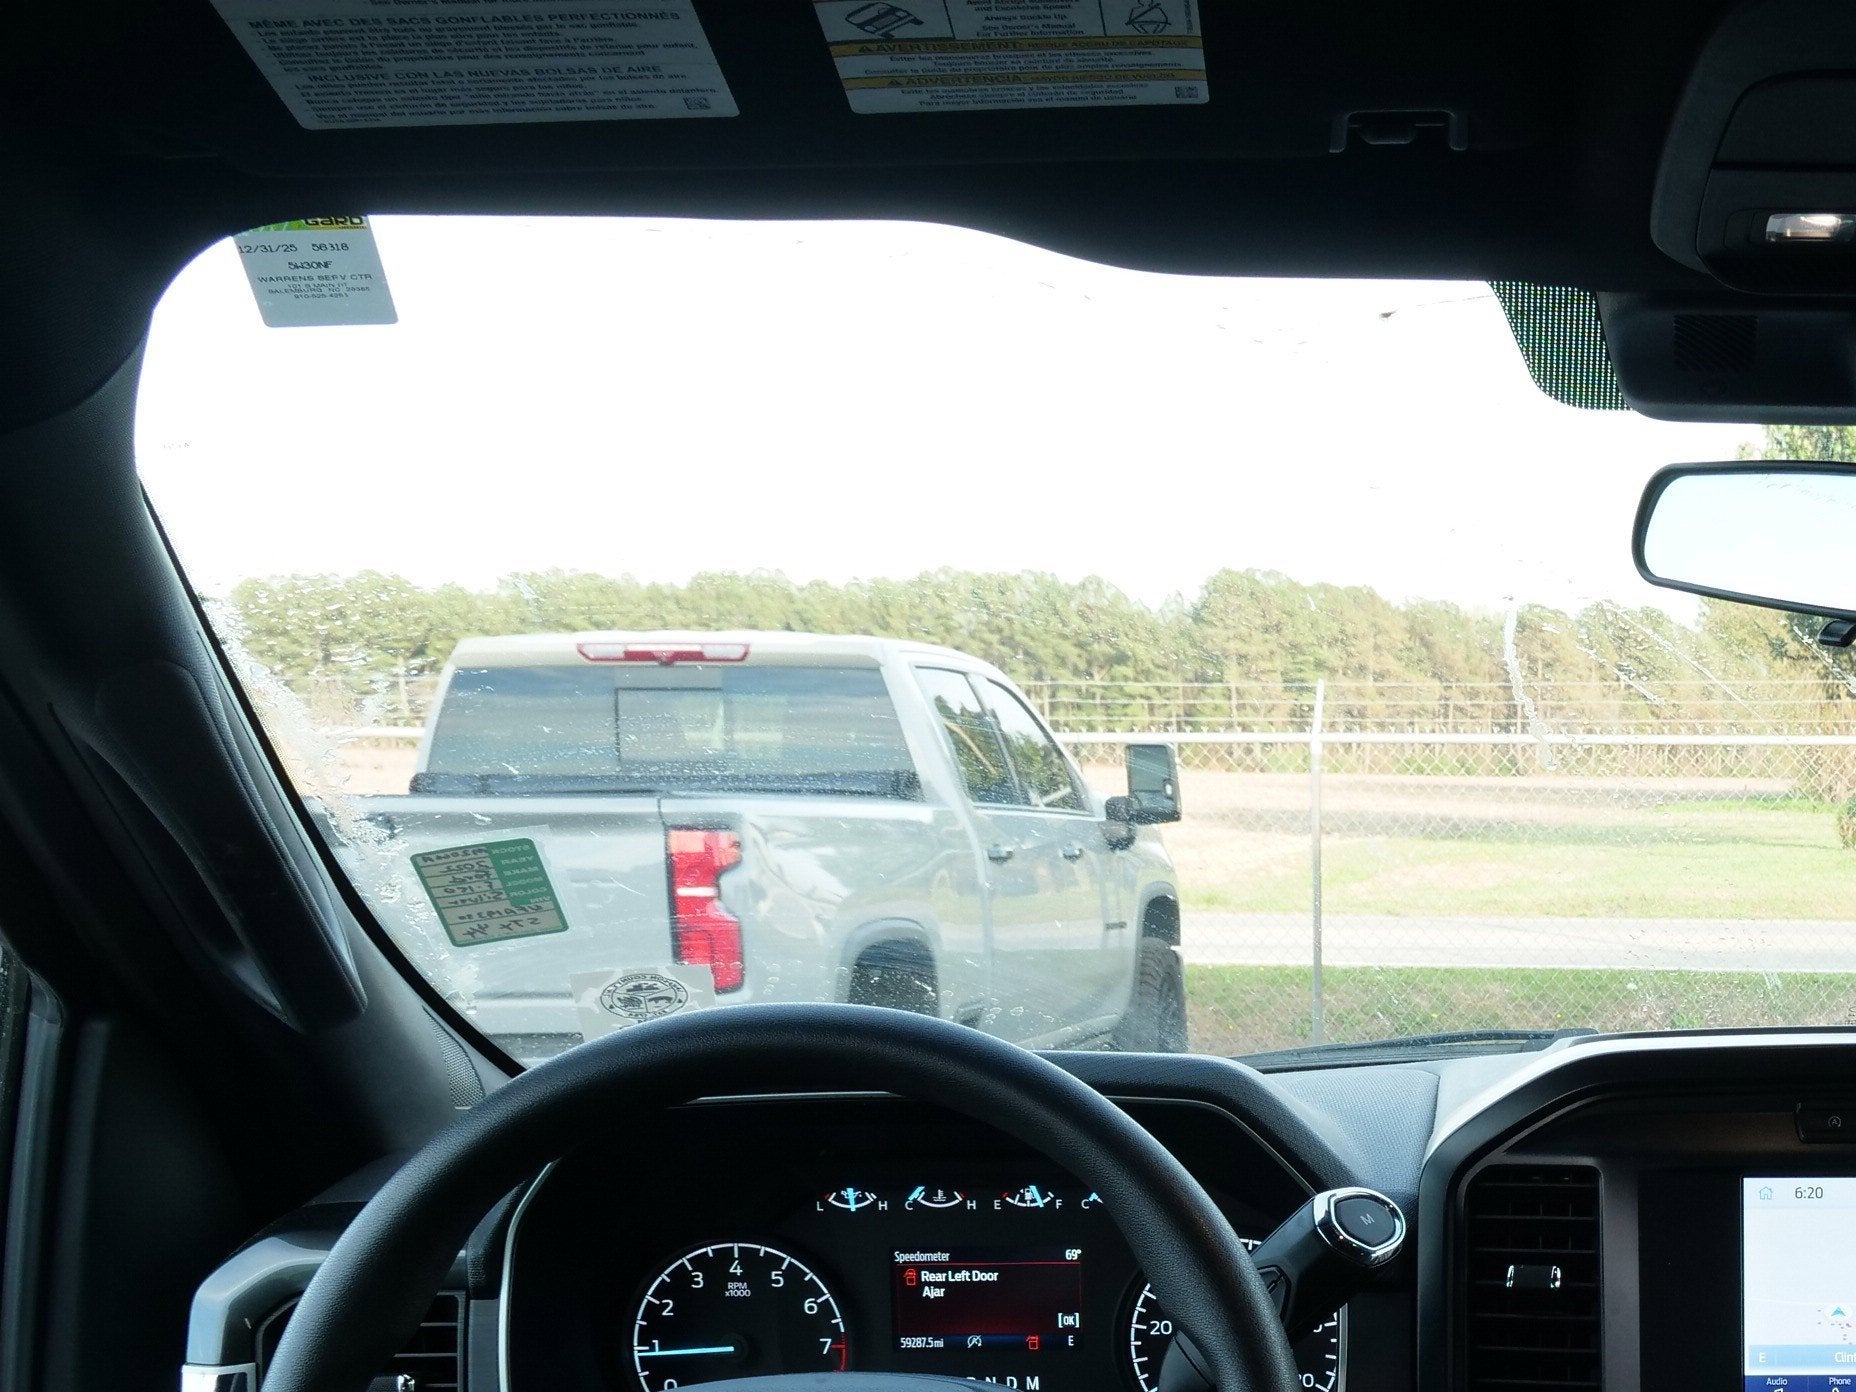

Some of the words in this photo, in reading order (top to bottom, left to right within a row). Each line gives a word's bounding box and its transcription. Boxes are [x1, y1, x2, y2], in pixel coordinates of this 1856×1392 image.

[303, 17, 345, 27] AVEC
[350, 17, 383, 26] DES
[386, 16, 431, 26] SACS
[308, 73, 389, 82] INCLUSIVE
[395, 71, 431, 80] CON
[432, 70, 464, 79] LAS
[467, 69, 530, 78] NUEVAS
[534, 67, 597, 76] BOLSAS
[627, 65, 661, 74] AIRE
[239, 244, 298, 254] 12/31/25
[258, 274, 315, 283] WARRENS
[1794, 1186, 1823, 1200] 6:20
[816, 1201, 824, 1211] L
[879, 1201, 889, 1211] H
[905, 1200, 914, 1211] C
[967, 1200, 977, 1210] H
[994, 1200, 1002, 1210] E
[1056, 1199, 1063, 1210] F
[1080, 1198, 1089, 1210] C
[894, 1251, 950, 1264] Speedometer
[730, 1260, 743, 1276] 4
[692, 1272, 704, 1288] 3
[772, 1271, 784, 1287] 5
[921, 1270, 947, 1282] Rear
[948, 1270, 970, 1282] Left
[972, 1270, 999, 1282] Door
[727, 1282, 748, 1291] RPM
[922, 1286, 945, 1299] Ajar
[662, 1300, 674, 1316] 2
[804, 1298, 818, 1315] 6
[1150, 1320, 1172, 1336] 20
[820, 1338, 832, 1355] 7
[1067, 1335, 1074, 1346] E
[1026, 1377, 1040, 1391] M
[1766, 1376, 1788, 1387] Audio
[1829, 1376, 1852, 1387] Phone
